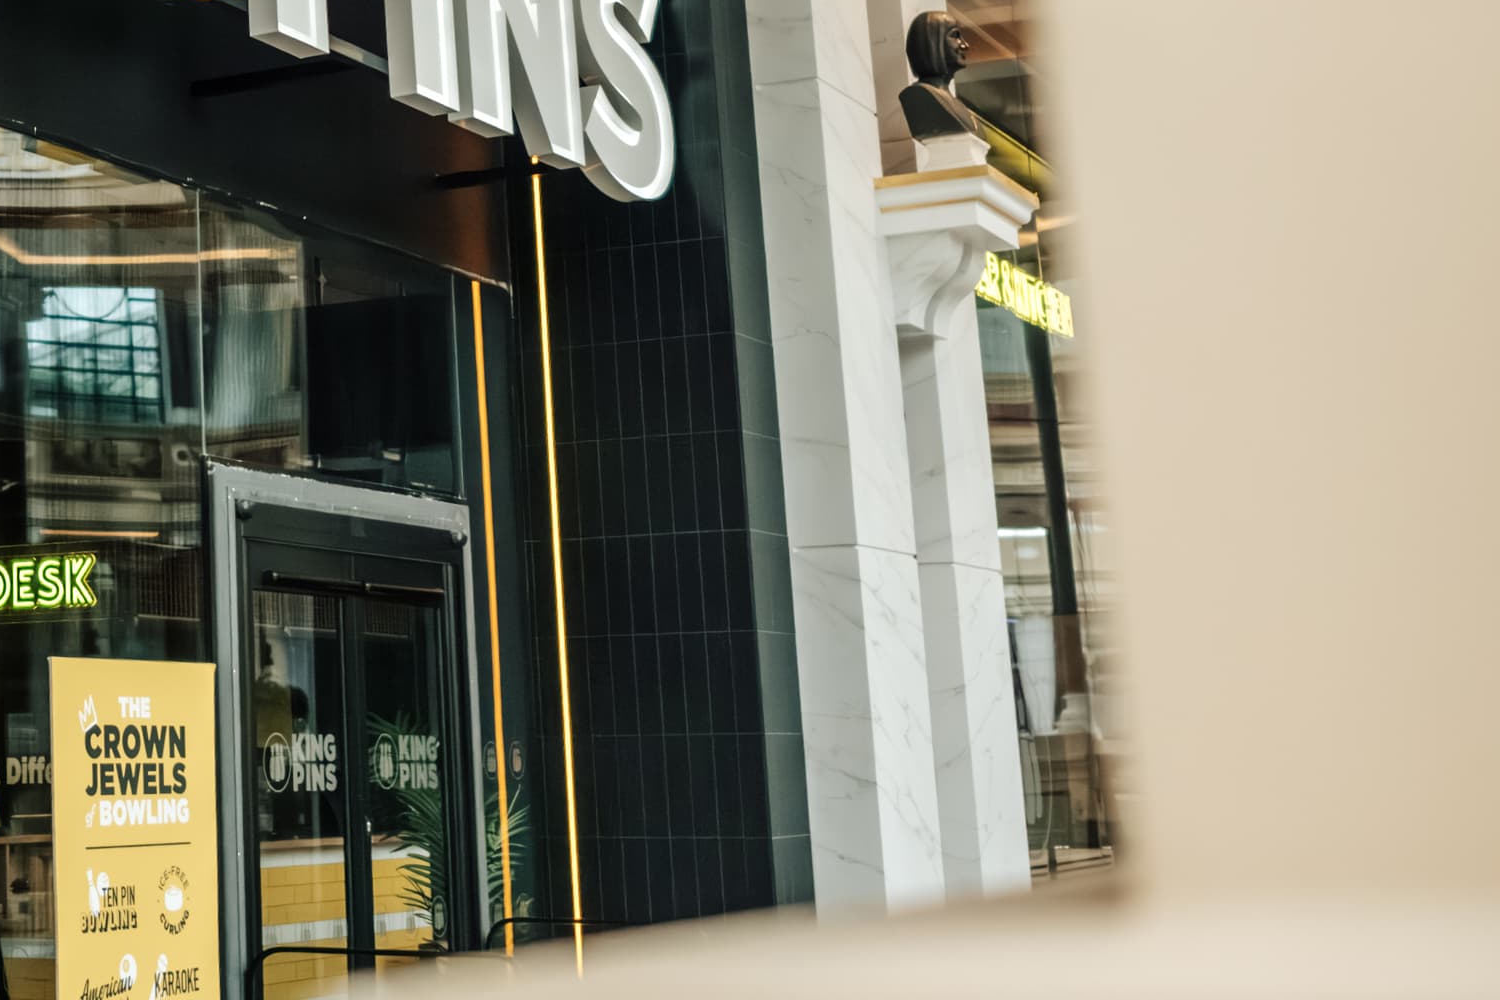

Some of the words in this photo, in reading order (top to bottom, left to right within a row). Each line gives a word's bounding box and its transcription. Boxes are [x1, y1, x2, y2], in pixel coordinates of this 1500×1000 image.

[118, 696, 151, 719] THE
[85, 724, 186, 759] CROWN
[291, 733, 337, 762] KING
[398, 734, 438, 762] KING
[85, 762, 187, 797] JEWELS
[291, 762, 337, 792] PINS
[398, 763, 438, 790] PINS
[99, 798, 190, 827] BOWLING
[102, 886, 119, 908] TEN
[121, 885, 136, 906] PIN
[81, 909, 138, 934] BOWLING
[159, 909, 190, 935] CURLING
[154, 967, 200, 998] KARAOKE
